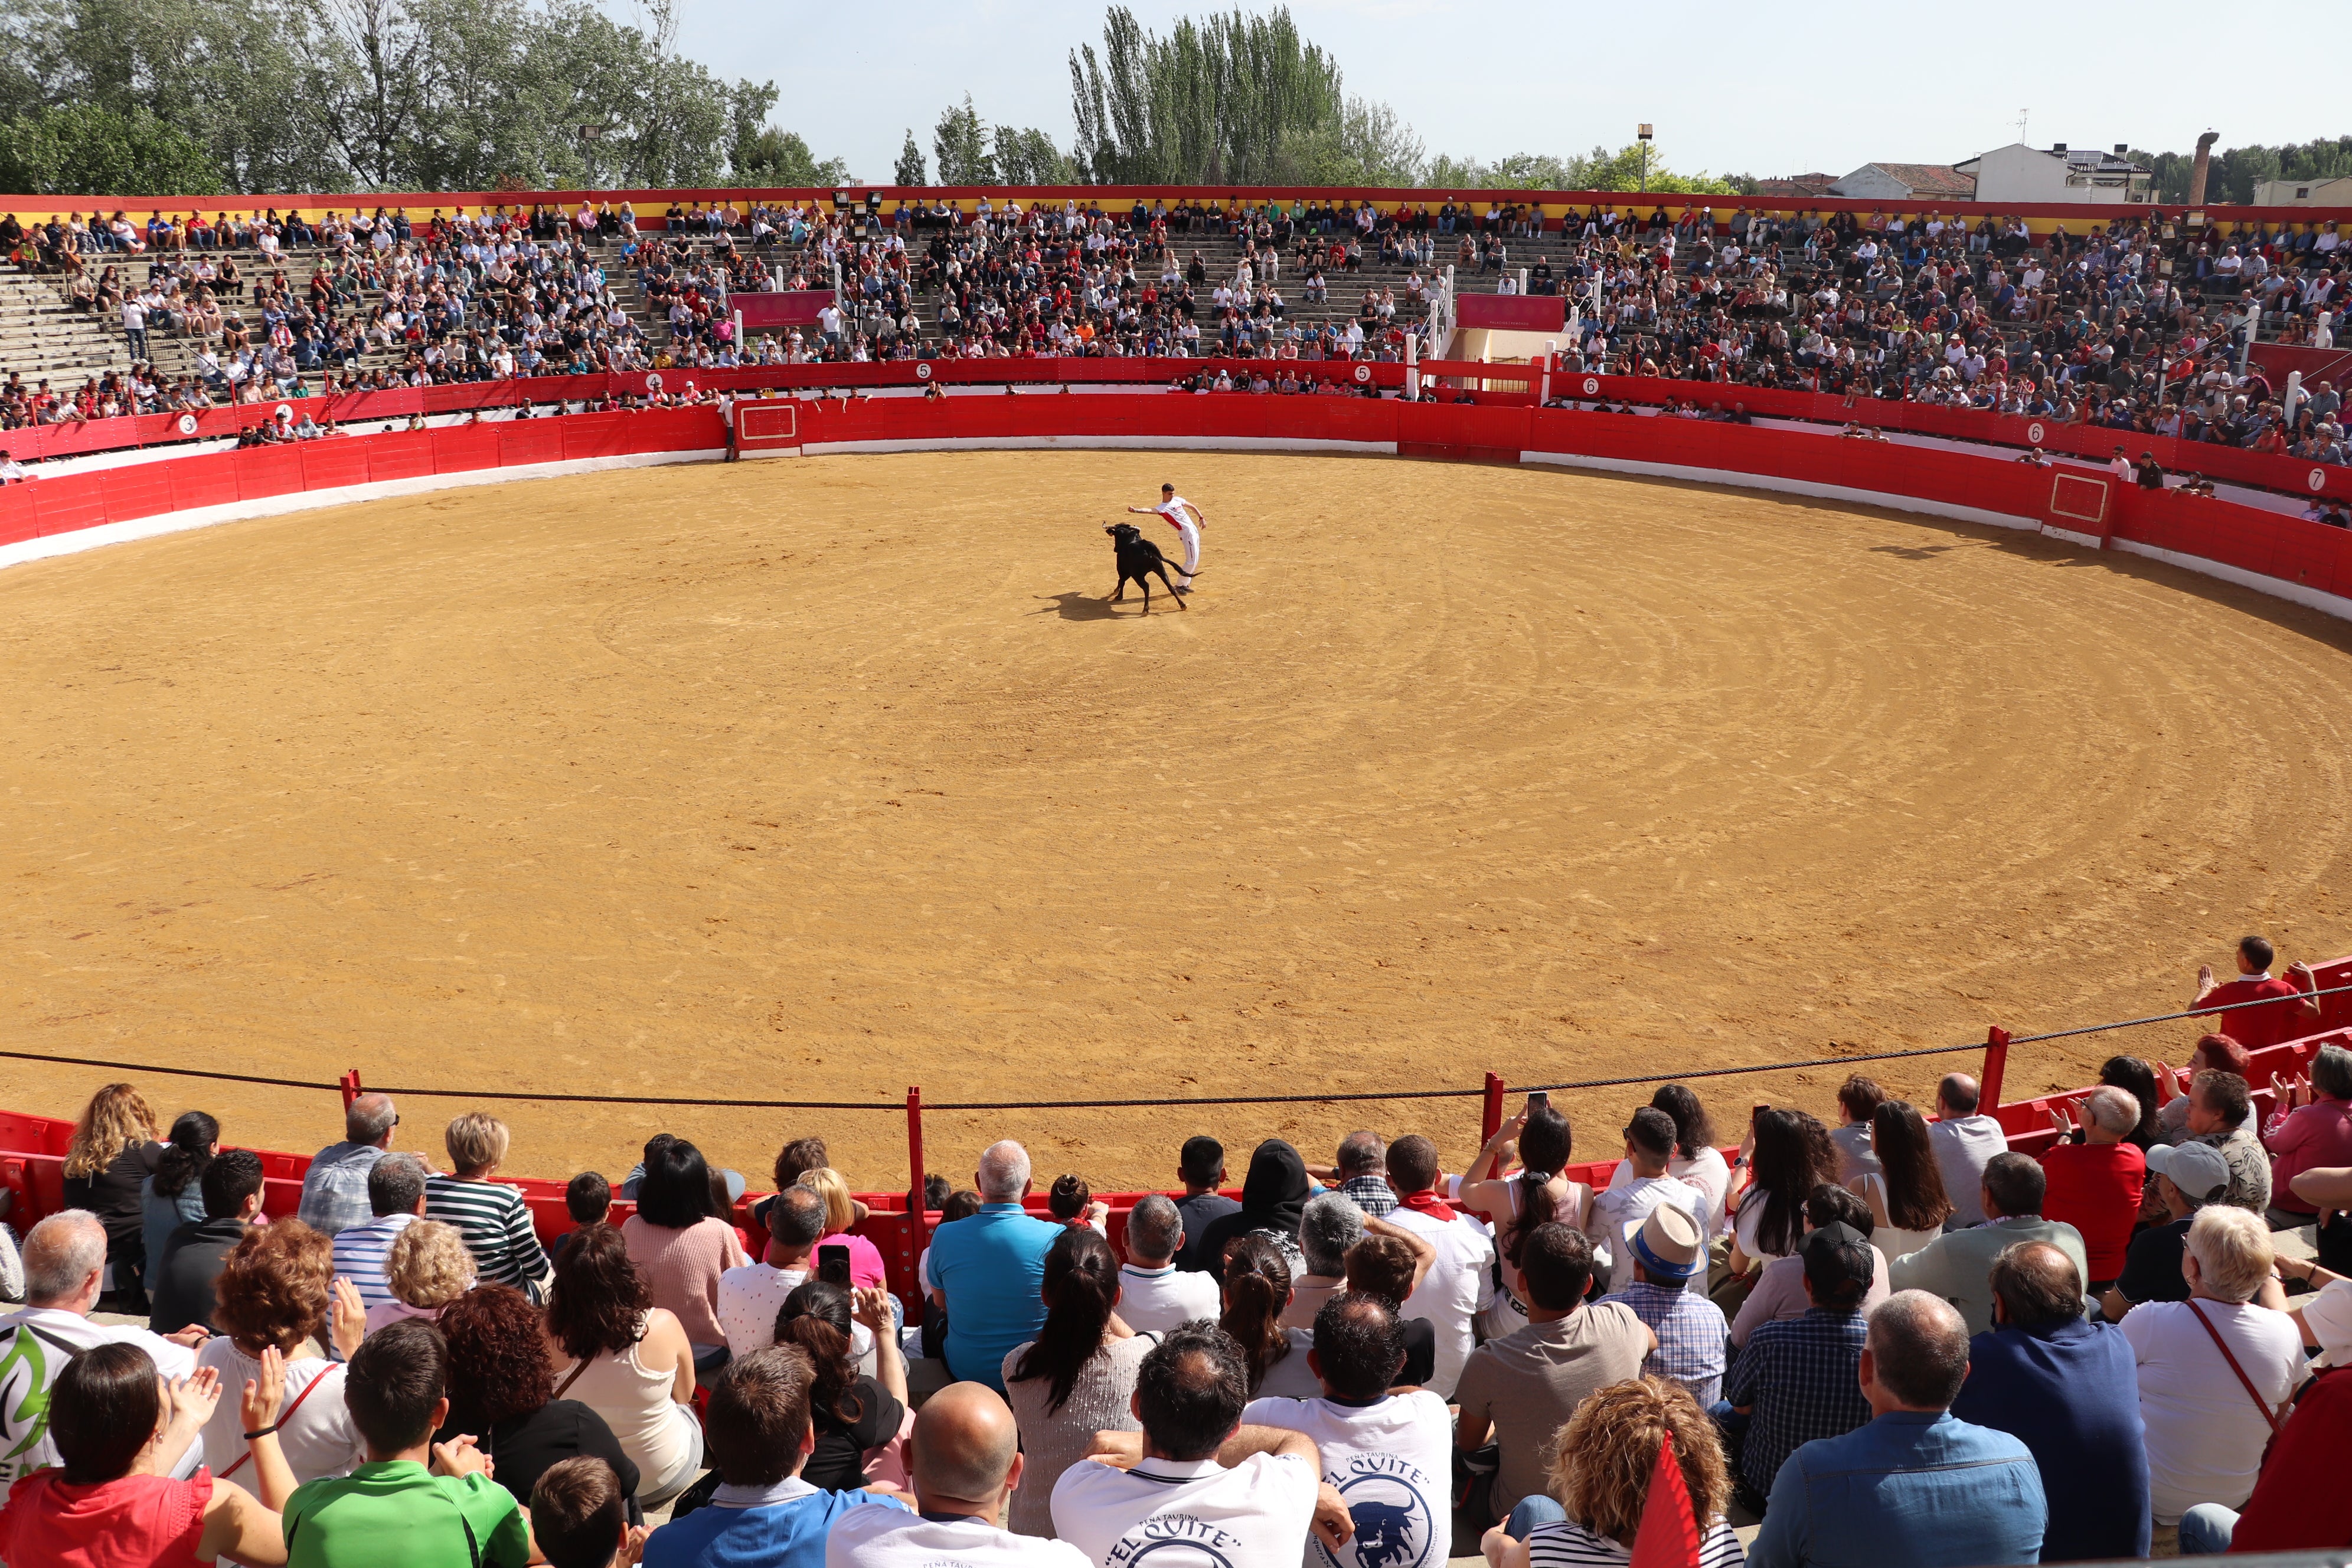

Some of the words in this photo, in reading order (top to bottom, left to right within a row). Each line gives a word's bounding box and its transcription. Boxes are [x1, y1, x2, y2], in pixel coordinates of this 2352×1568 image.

[920, 365, 927, 377] 5
[1358, 367, 1367, 380] 5
[650, 376, 657, 386] 4
[1587, 380, 1595, 393] 6
[184, 417, 193, 431] 3
[2032, 426, 2040, 440] 6
[2312, 471, 2322, 487] 7
[1696, 1175, 1709, 1186] GRUPO
[1345, 1453, 1365, 1462] PEÑA
[1366, 1452, 1399, 1460] TAURINA
[1139, 1515, 1161, 1527] PEÑA
[1162, 1514, 1199, 1522] TAURINA
